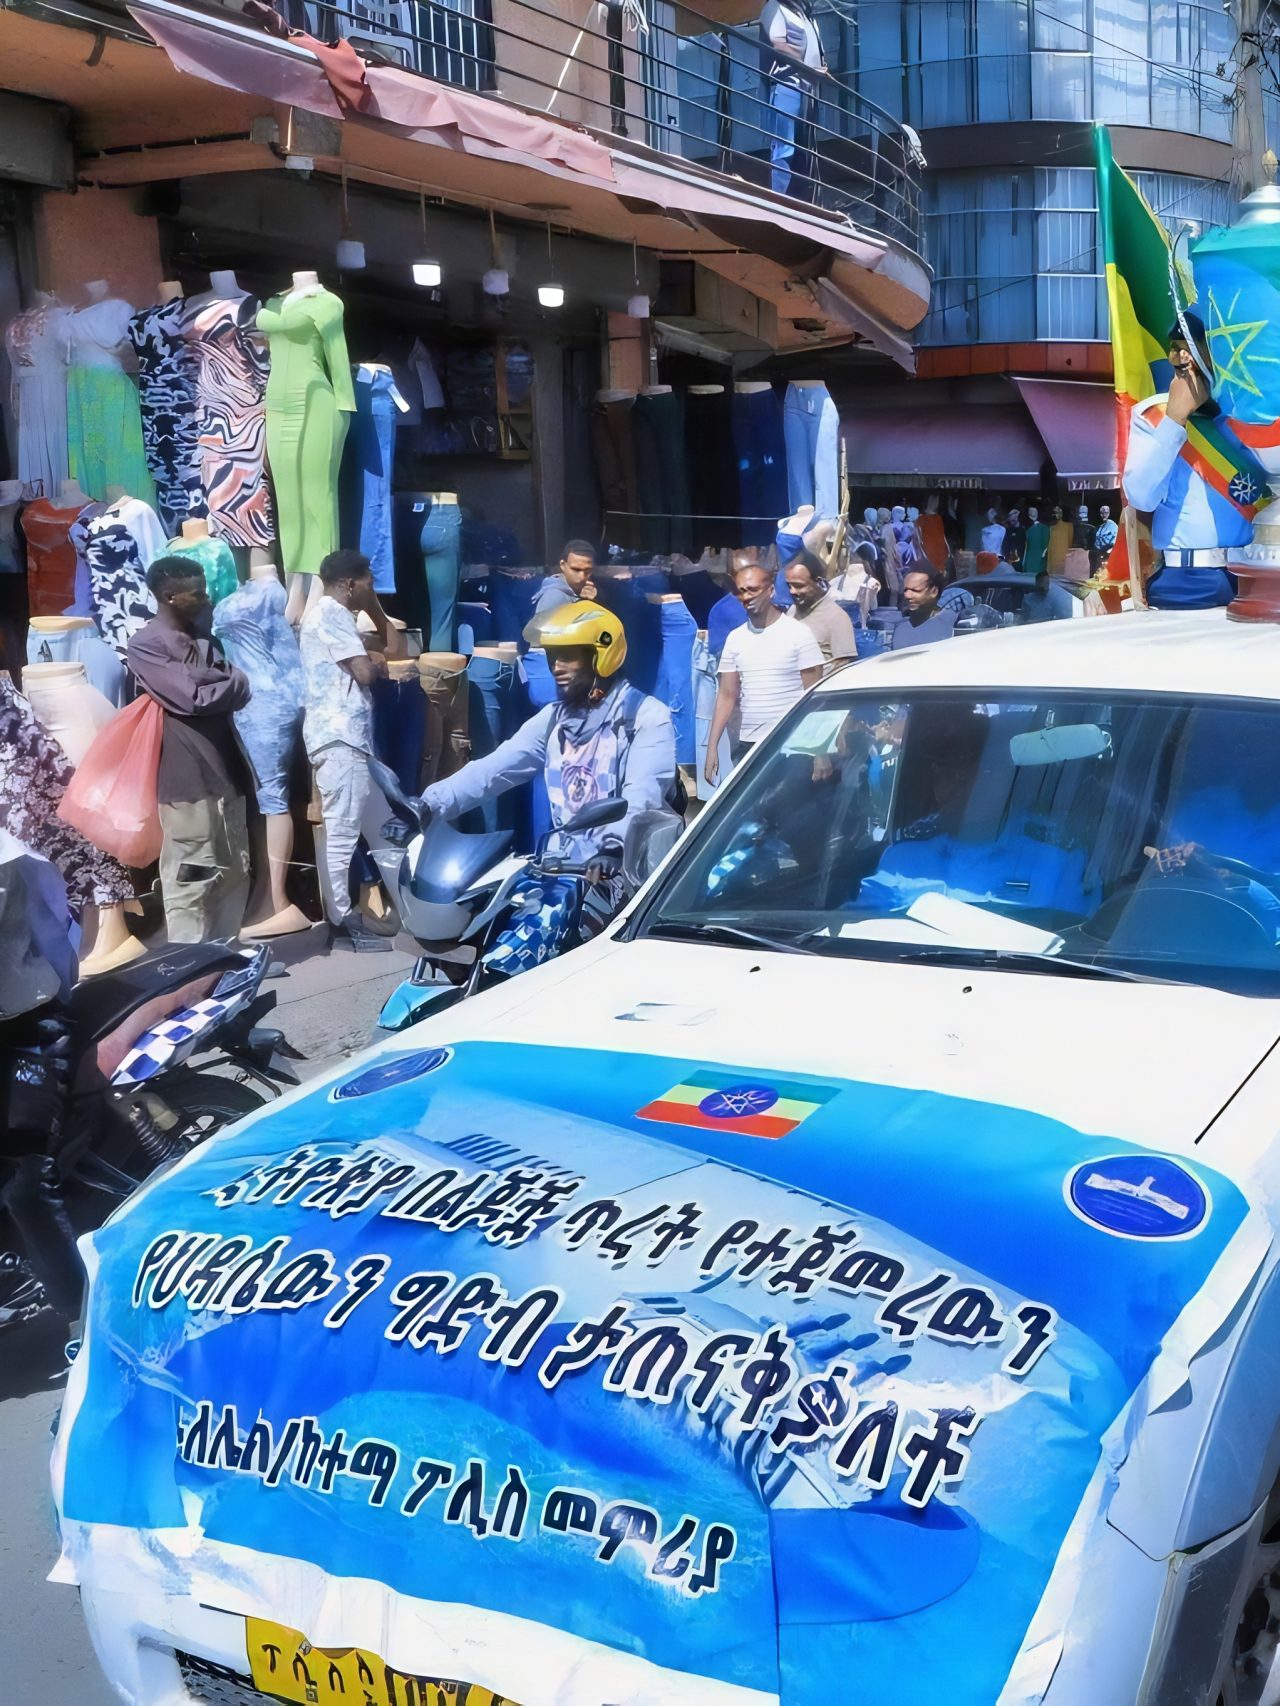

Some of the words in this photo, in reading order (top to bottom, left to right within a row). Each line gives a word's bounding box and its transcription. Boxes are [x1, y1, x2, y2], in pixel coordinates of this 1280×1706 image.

[390, 1275, 560, 1362] ግድብ
[565, 1198, 703, 1261] ጥረት
[700, 1218, 1054, 1370] የተጀመረውን
[402, 1460, 529, 1538] ፖሊስ
[541, 1489, 736, 1593] መምሪያ
